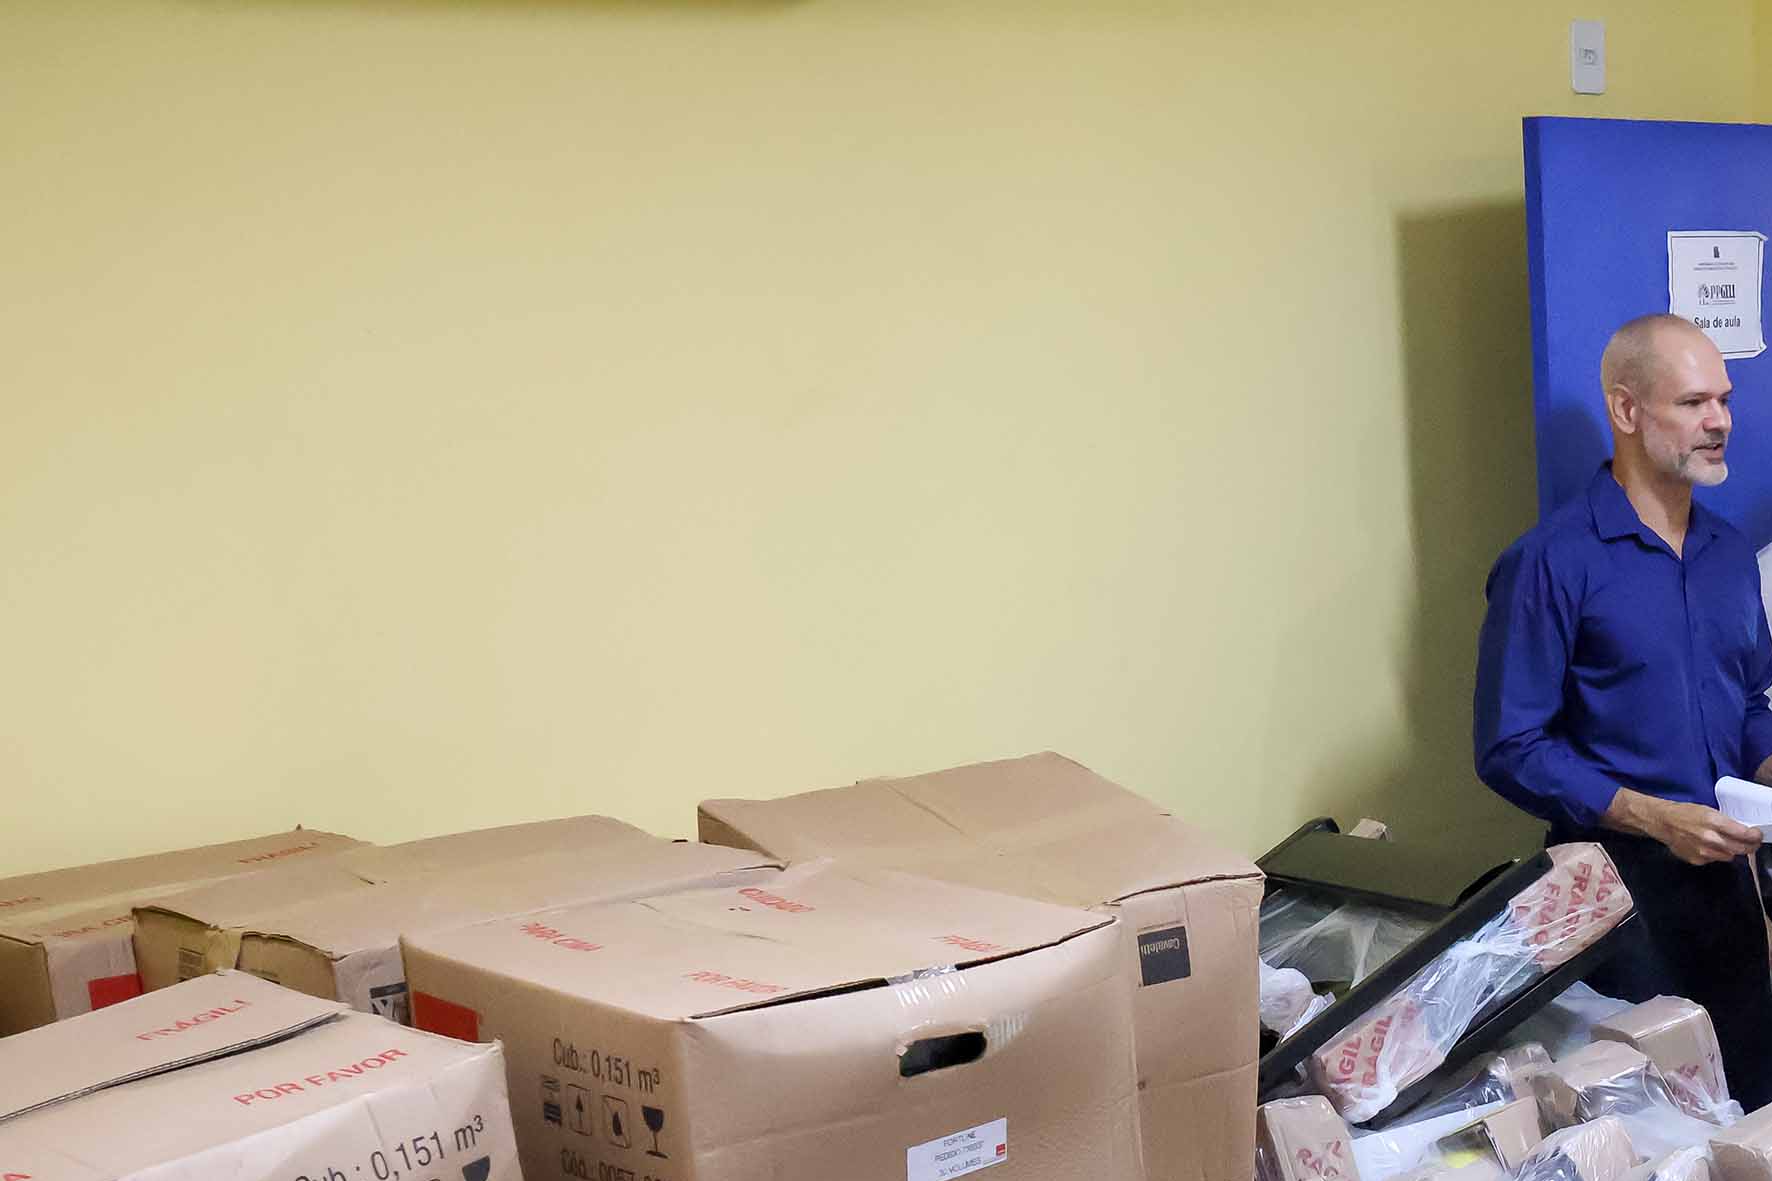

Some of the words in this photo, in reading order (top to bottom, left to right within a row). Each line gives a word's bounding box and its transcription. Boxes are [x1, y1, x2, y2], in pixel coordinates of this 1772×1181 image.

[1713, 316, 1722, 328] de
[1725, 315, 1741, 328] aula
[232, 1081, 304, 1106] POR
[304, 1047, 408, 1087] FAVOR
[370, 1131, 445, 1181] 0,151
